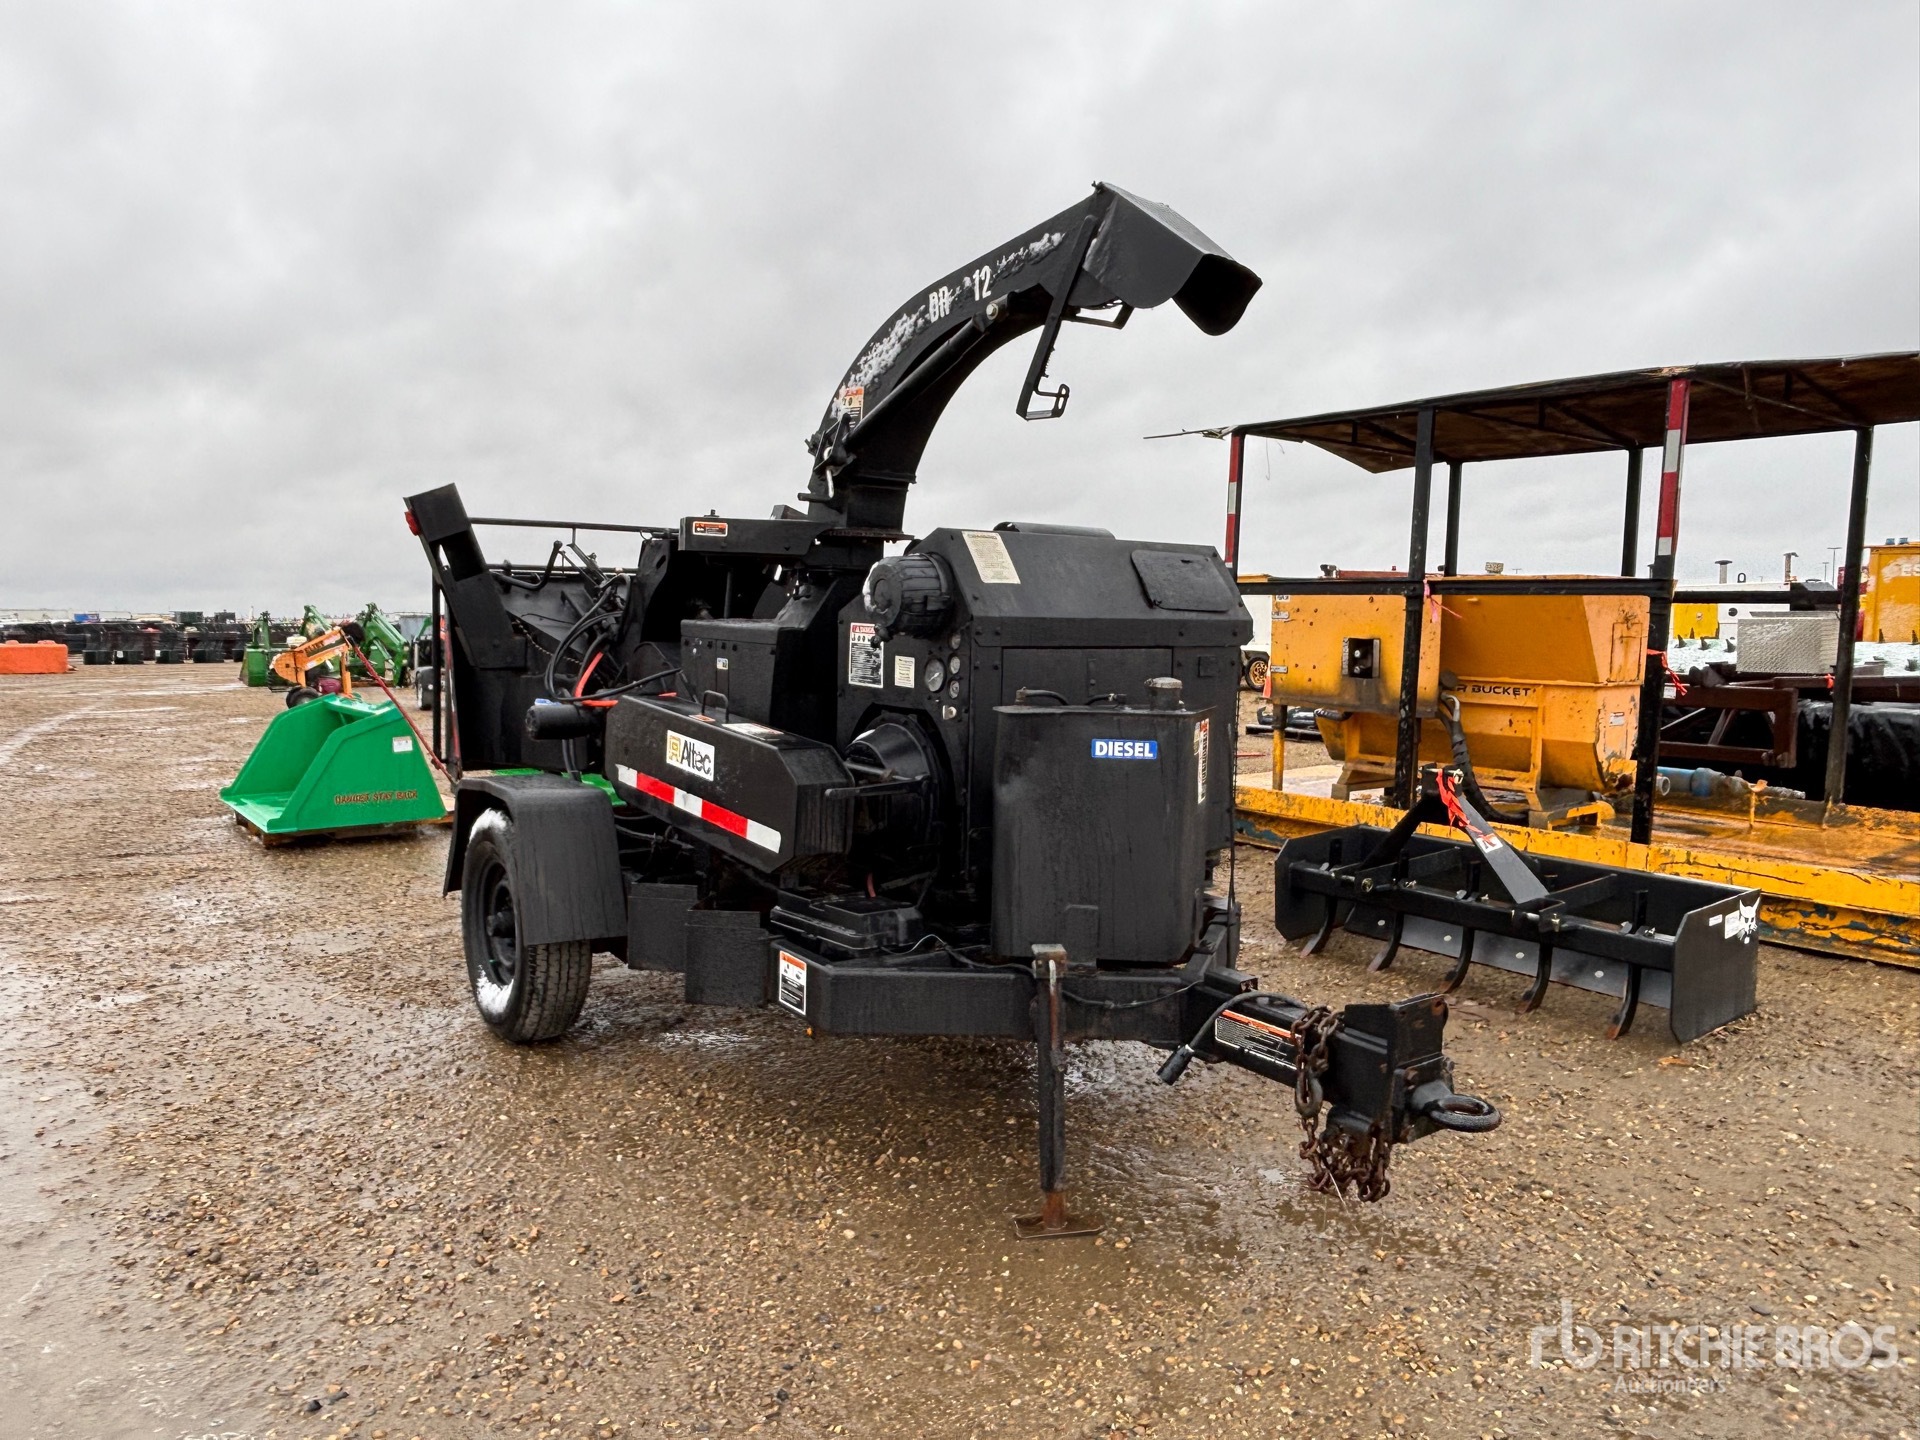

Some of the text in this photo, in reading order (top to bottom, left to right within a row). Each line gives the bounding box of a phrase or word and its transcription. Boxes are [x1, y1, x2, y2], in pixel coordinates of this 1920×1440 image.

[973, 265, 992, 302] 12
[1471, 684, 1531, 696] BUCKET
[680, 740, 711, 774] Altec
[1094, 740, 1153, 757] DIESEL
